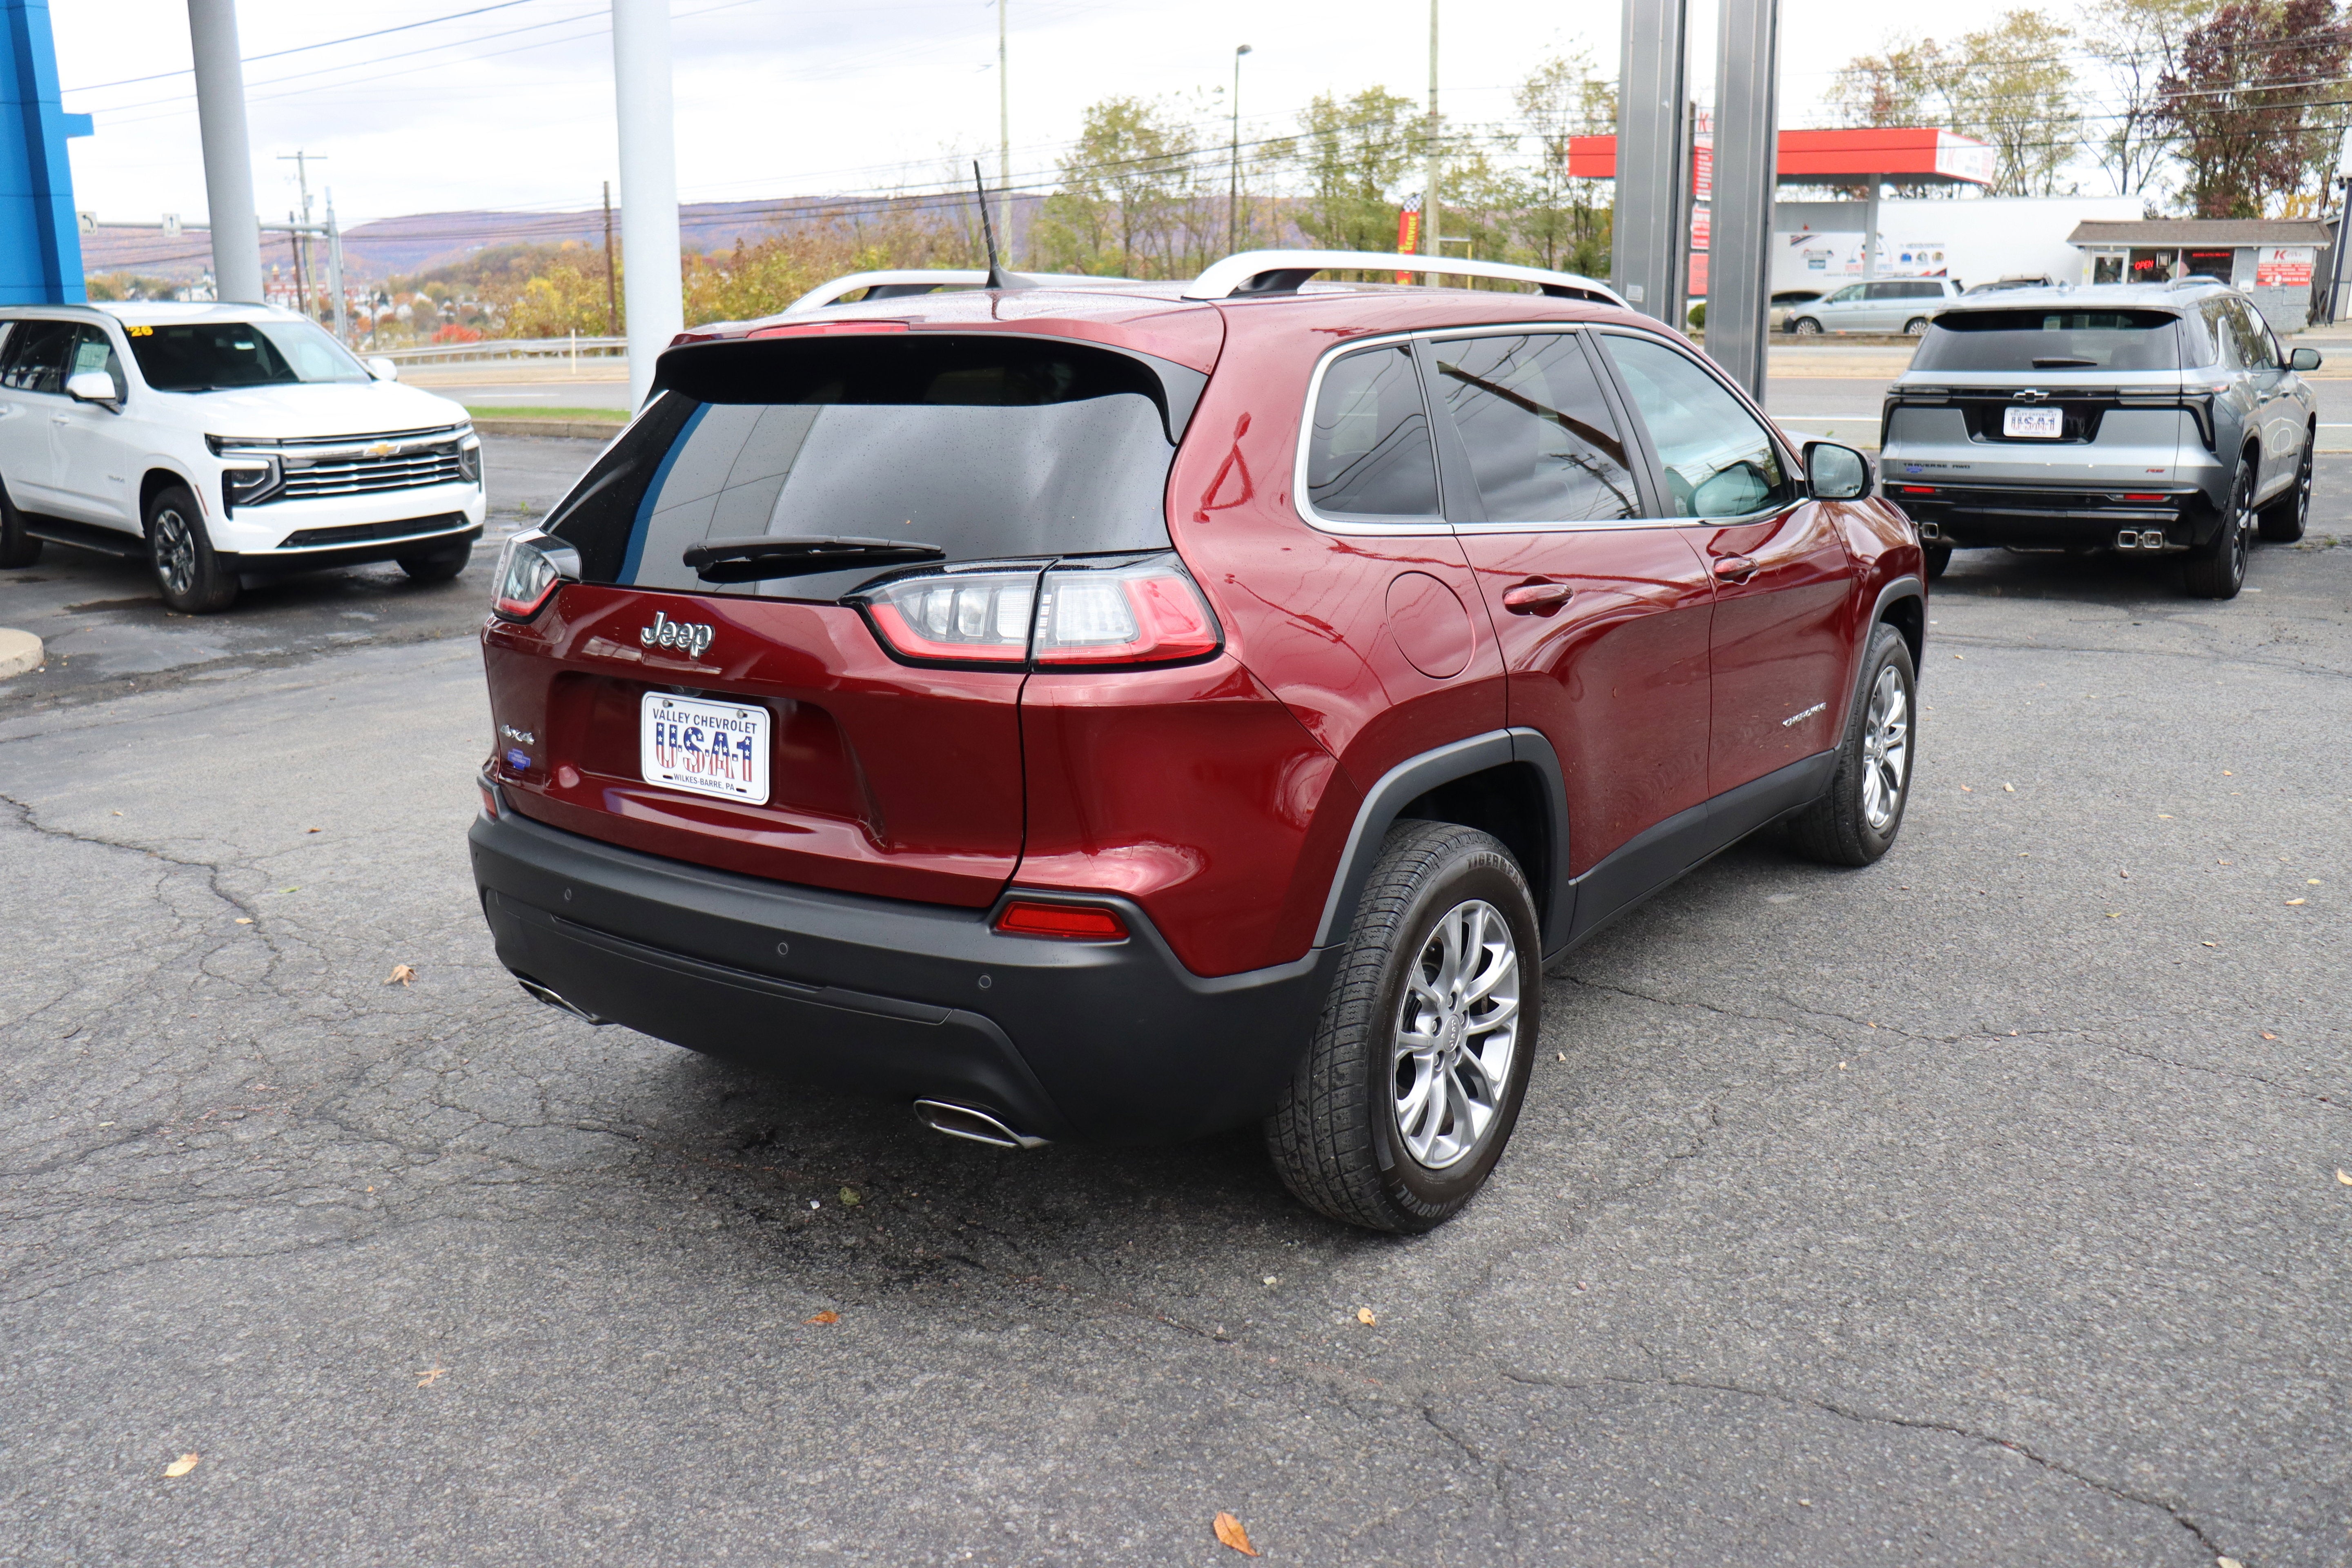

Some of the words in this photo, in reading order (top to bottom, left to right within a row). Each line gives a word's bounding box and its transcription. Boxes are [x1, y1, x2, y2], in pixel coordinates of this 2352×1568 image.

[2134, 260, 2154, 270] OPEN
[641, 611, 715, 660] Jeep
[653, 708, 690, 724] VALLEY
[693, 714, 757, 734] CHEVROLET
[674, 773, 724, 791] WILKES-BARRE,
[726, 782, 735, 791] PA
